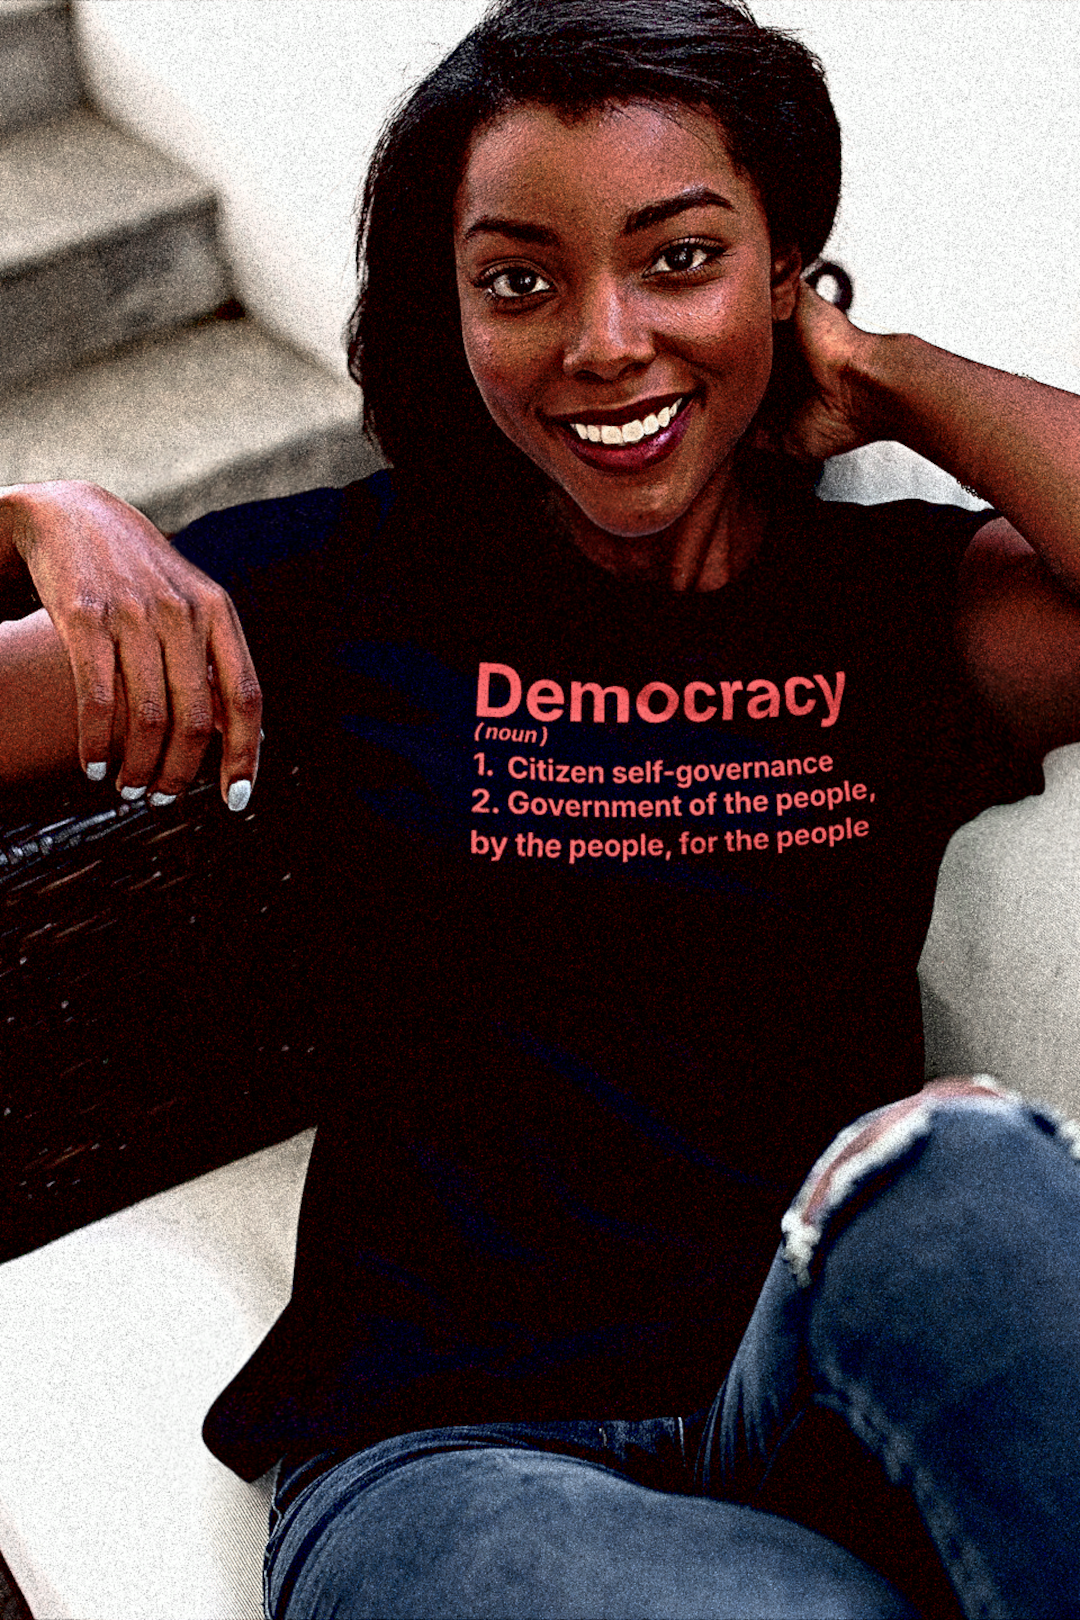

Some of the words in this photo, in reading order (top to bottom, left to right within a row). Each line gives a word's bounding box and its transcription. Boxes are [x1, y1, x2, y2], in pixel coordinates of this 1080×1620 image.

[475, 661, 846, 728] Democracy
[474, 721, 548, 747] (noun)
[473, 752, 494, 777] 1.
[507, 755, 605, 784] Citizen
[612, 754, 834, 789] self-governance
[471, 787, 500, 814] 2.
[507, 790, 683, 818] Government
[688, 791, 718, 817] of
[723, 790, 769, 815] the
[776, 780, 876, 817] people,
[470, 829, 509, 862] by
[514, 831, 562, 859] the
[568, 832, 672, 865] people,
[678, 830, 719, 855] for
[723, 829, 770, 853] the
[776, 817, 870, 854] people
